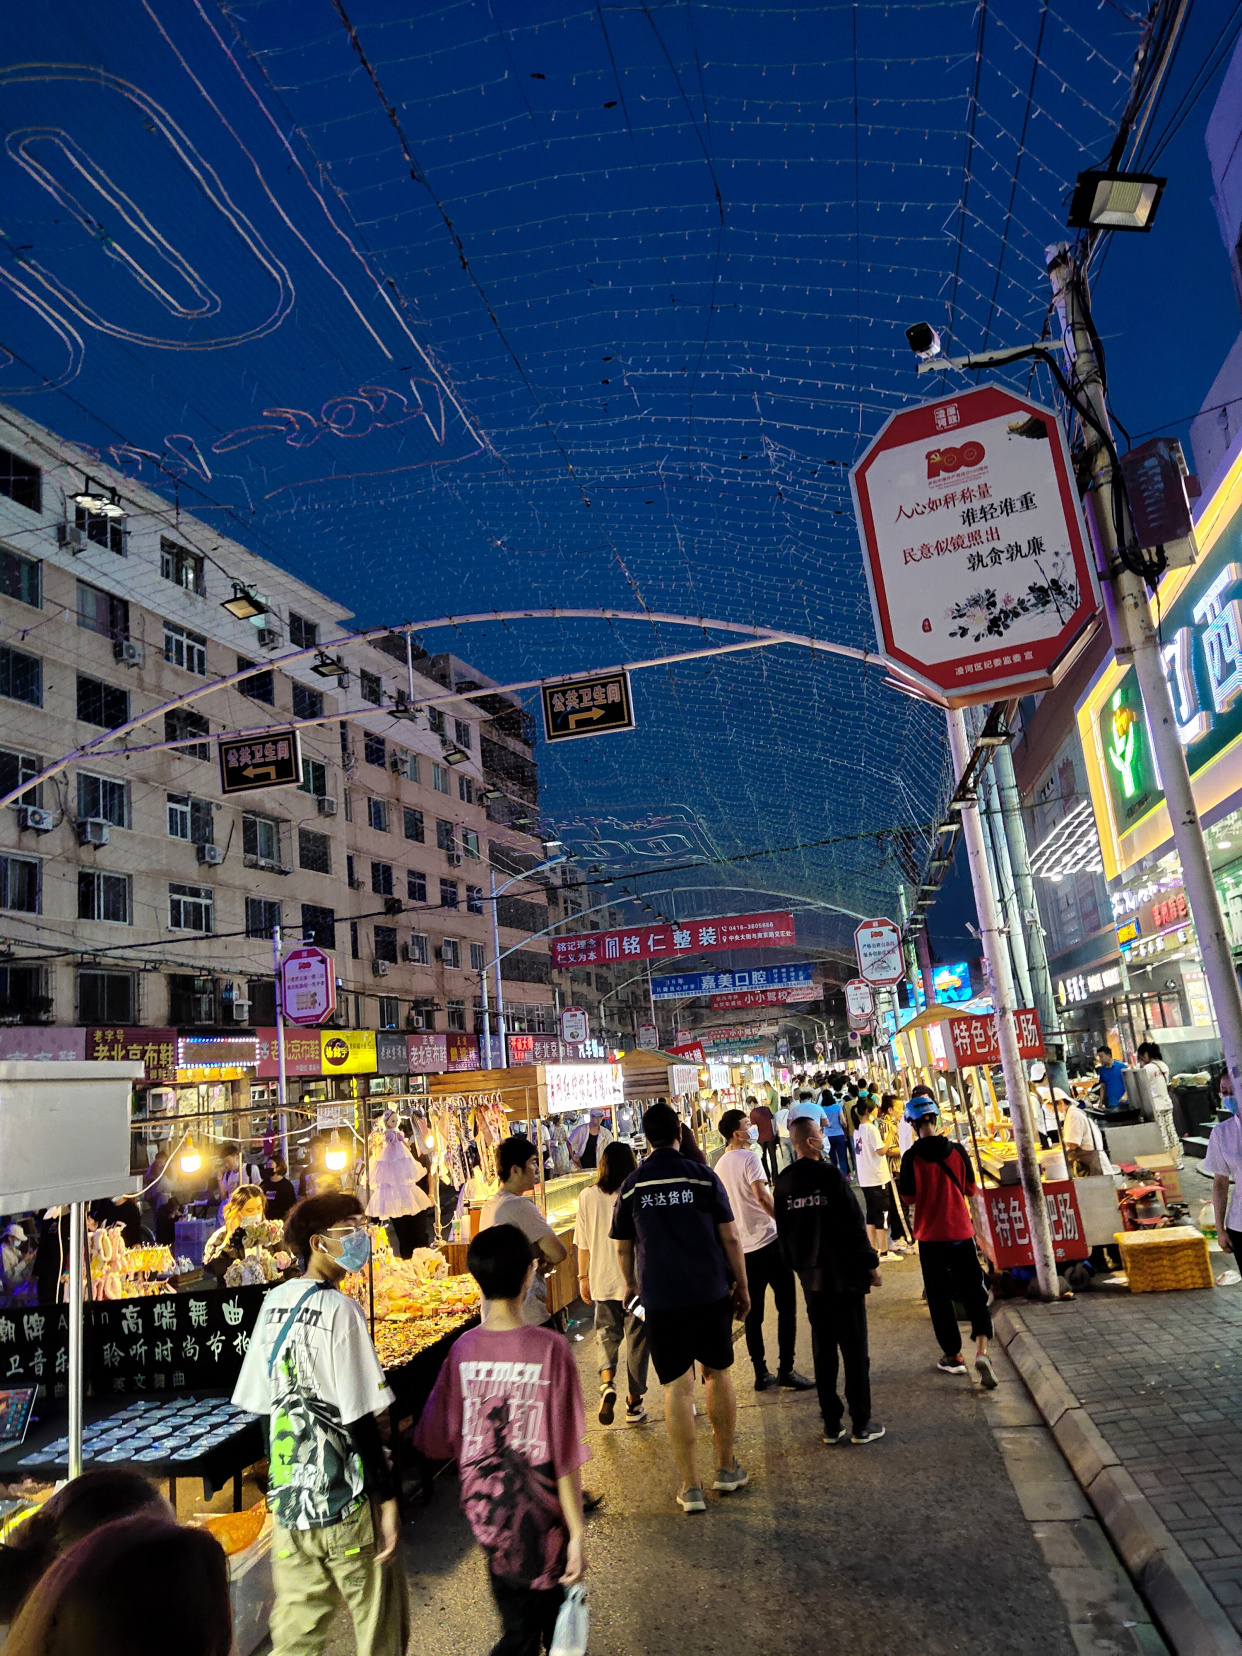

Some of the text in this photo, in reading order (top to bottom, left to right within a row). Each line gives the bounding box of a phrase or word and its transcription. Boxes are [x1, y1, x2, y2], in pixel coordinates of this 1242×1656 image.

[894, 483, 993, 523] 人心如秤称量
[959, 491, 1038, 527] 谁轻谁重
[902, 526, 1000, 565] 民意似镜照出
[966, 536, 1046, 571] 孰贪孰廉
[955, 650, 1034, 675] 凌河区纪委监委 宣
[551, 683, 621, 712] 公共卫生间
[227, 740, 290, 768] 公共卫生间
[556, 938, 597, 952] 铭记理念
[622, 927, 717, 954] 铭仁整装
[556, 951, 597, 964] 仁义为本
[701, 970, 767, 990] 嘉美口腔
[744, 990, 789, 1004] 小小驾校
[93, 1029, 125, 1043] 老字号
[93, 1042, 175, 1068] 老北京布鞋
[410, 1045, 447, 1066] 老北京布鞋
[641, 1189, 694, 1208] 兴达货的
[991, 1193, 1078, 1247] 特色肥肠
[121, 1295, 243, 1335] 高端舞曲
[103, 1330, 250, 1368] 聆听时尚节拍
[112, 1371, 186, 1391] 英文舞曲
